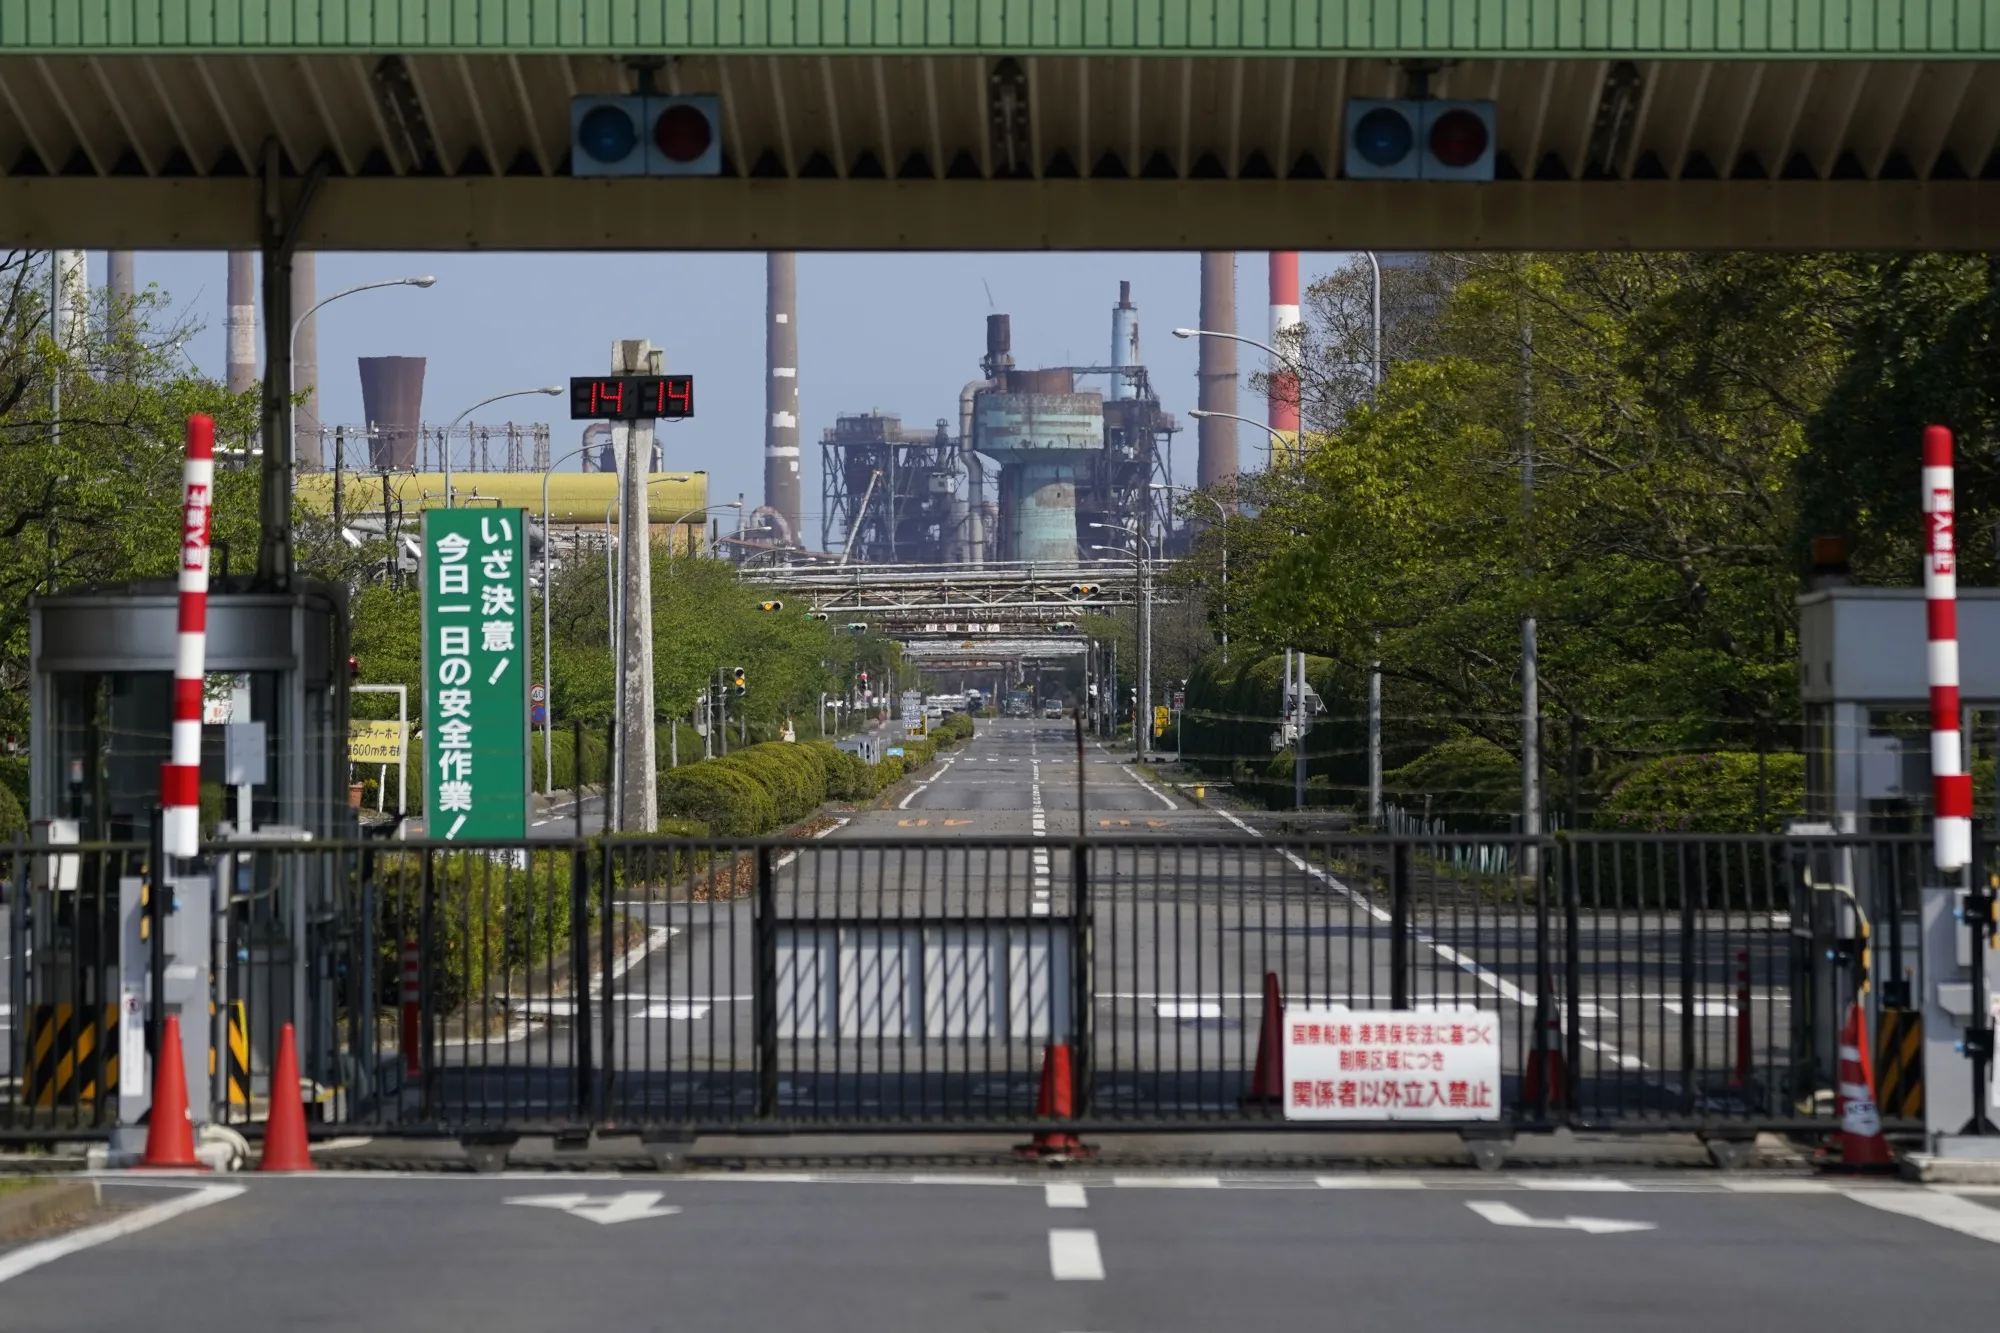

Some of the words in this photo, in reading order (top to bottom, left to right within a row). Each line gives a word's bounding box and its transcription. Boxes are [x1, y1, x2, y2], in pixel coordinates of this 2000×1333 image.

[590, 381, 624, 414] 14
[657, 380, 691, 412] 14
[436, 532, 473, 840] 今日一日の安全作業！
[532, 690, 544, 699] 40
[1292, 1080, 1493, 1109] 関係者以外立入禁止
